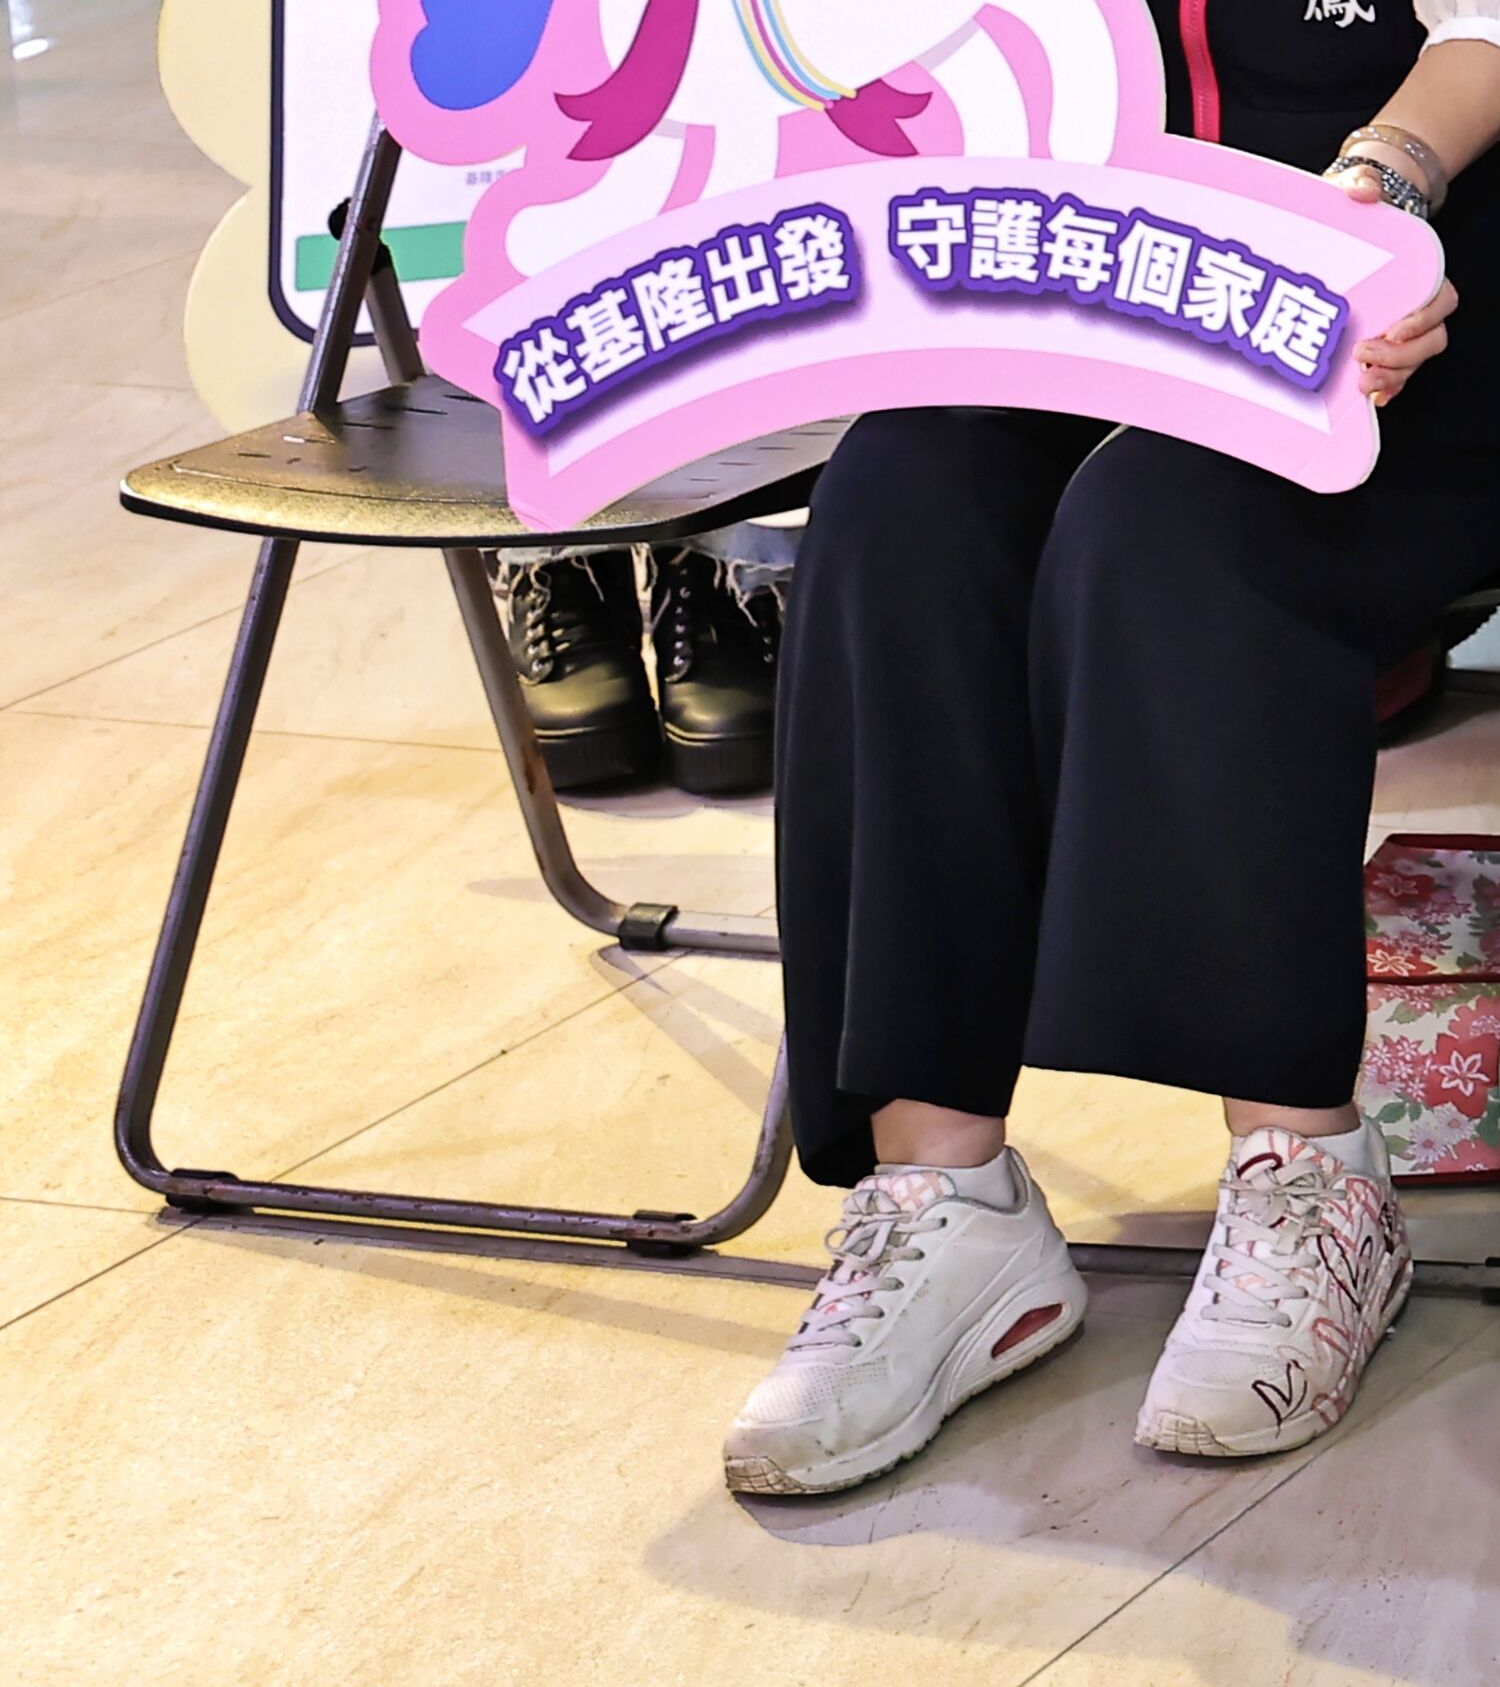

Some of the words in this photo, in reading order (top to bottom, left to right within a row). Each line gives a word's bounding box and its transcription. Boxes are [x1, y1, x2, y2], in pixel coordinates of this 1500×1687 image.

[502, 215, 852, 424] 從基隆出發
[893, 197, 1341, 379] 守護每個家庭
